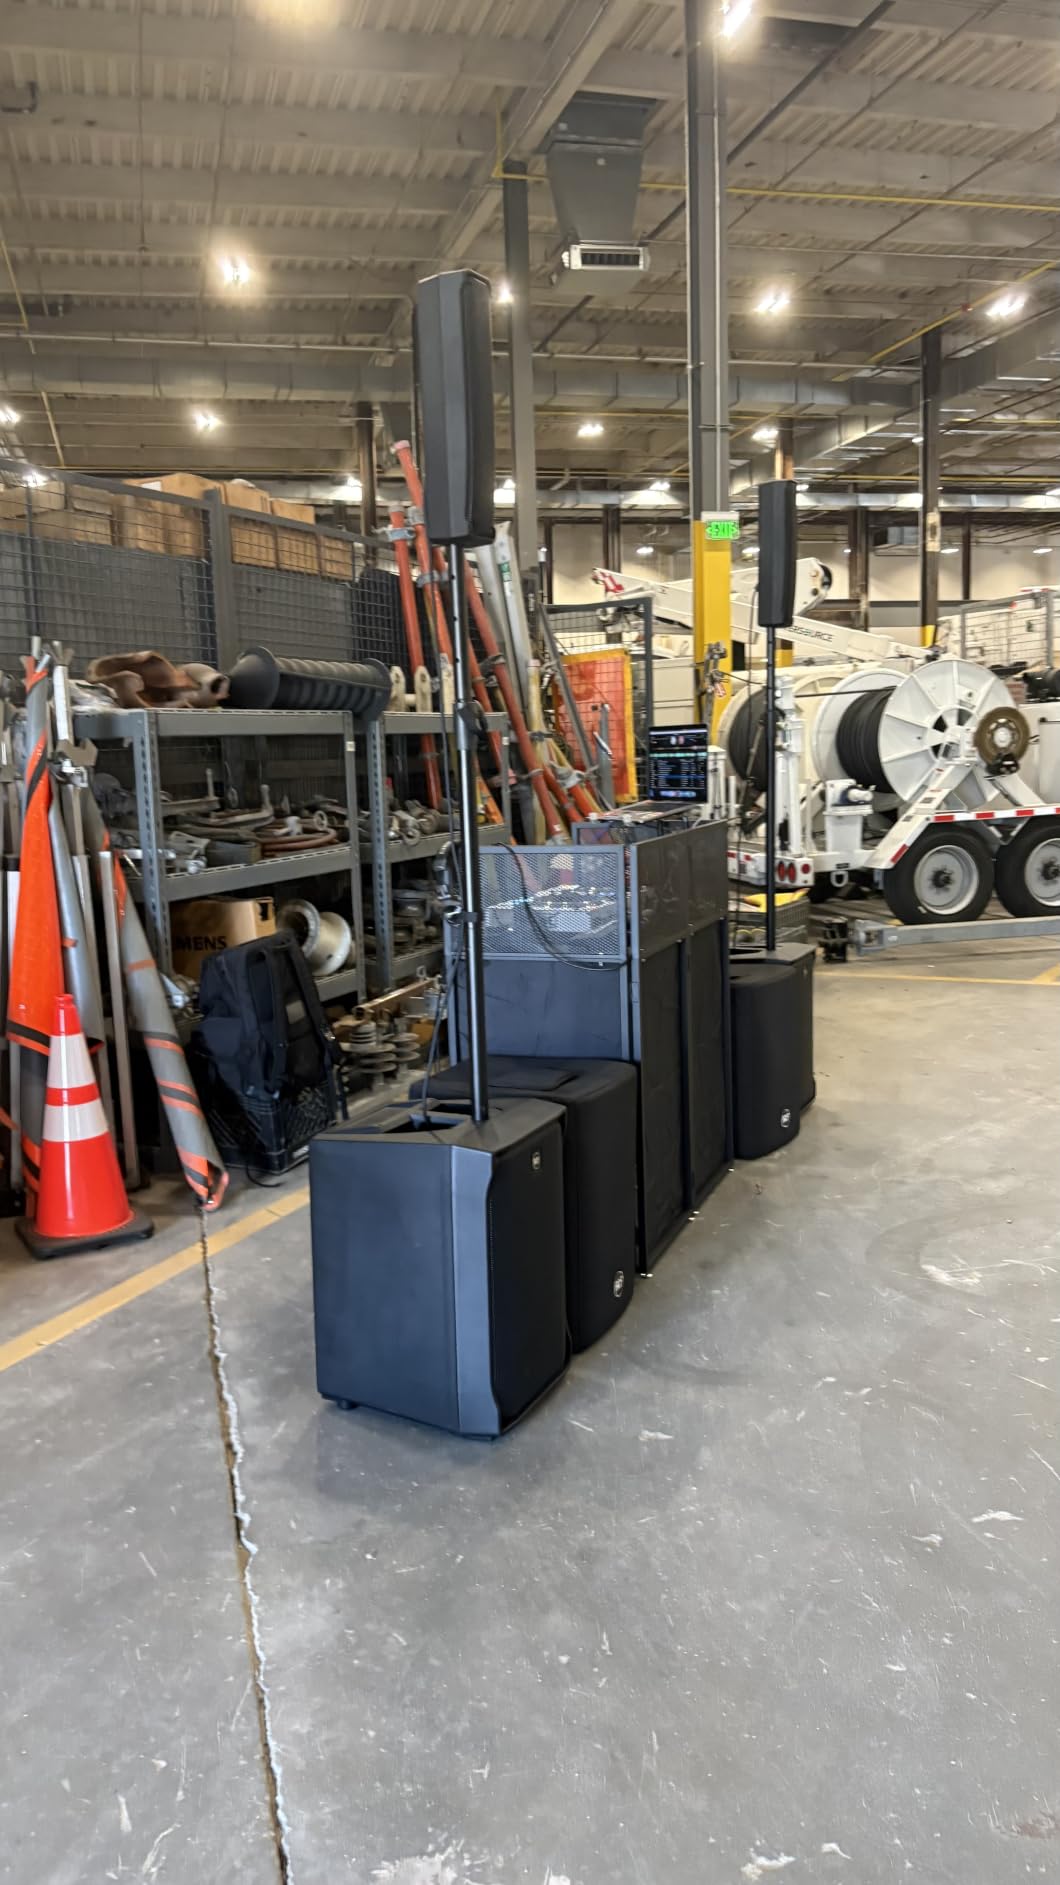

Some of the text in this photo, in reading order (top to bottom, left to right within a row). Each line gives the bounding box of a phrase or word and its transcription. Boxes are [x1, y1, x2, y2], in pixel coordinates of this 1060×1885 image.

[710, 521, 734, 538] EXIT
[787, 625, 833, 643] ERSOURCE
[175, 935, 227, 951] MENS
